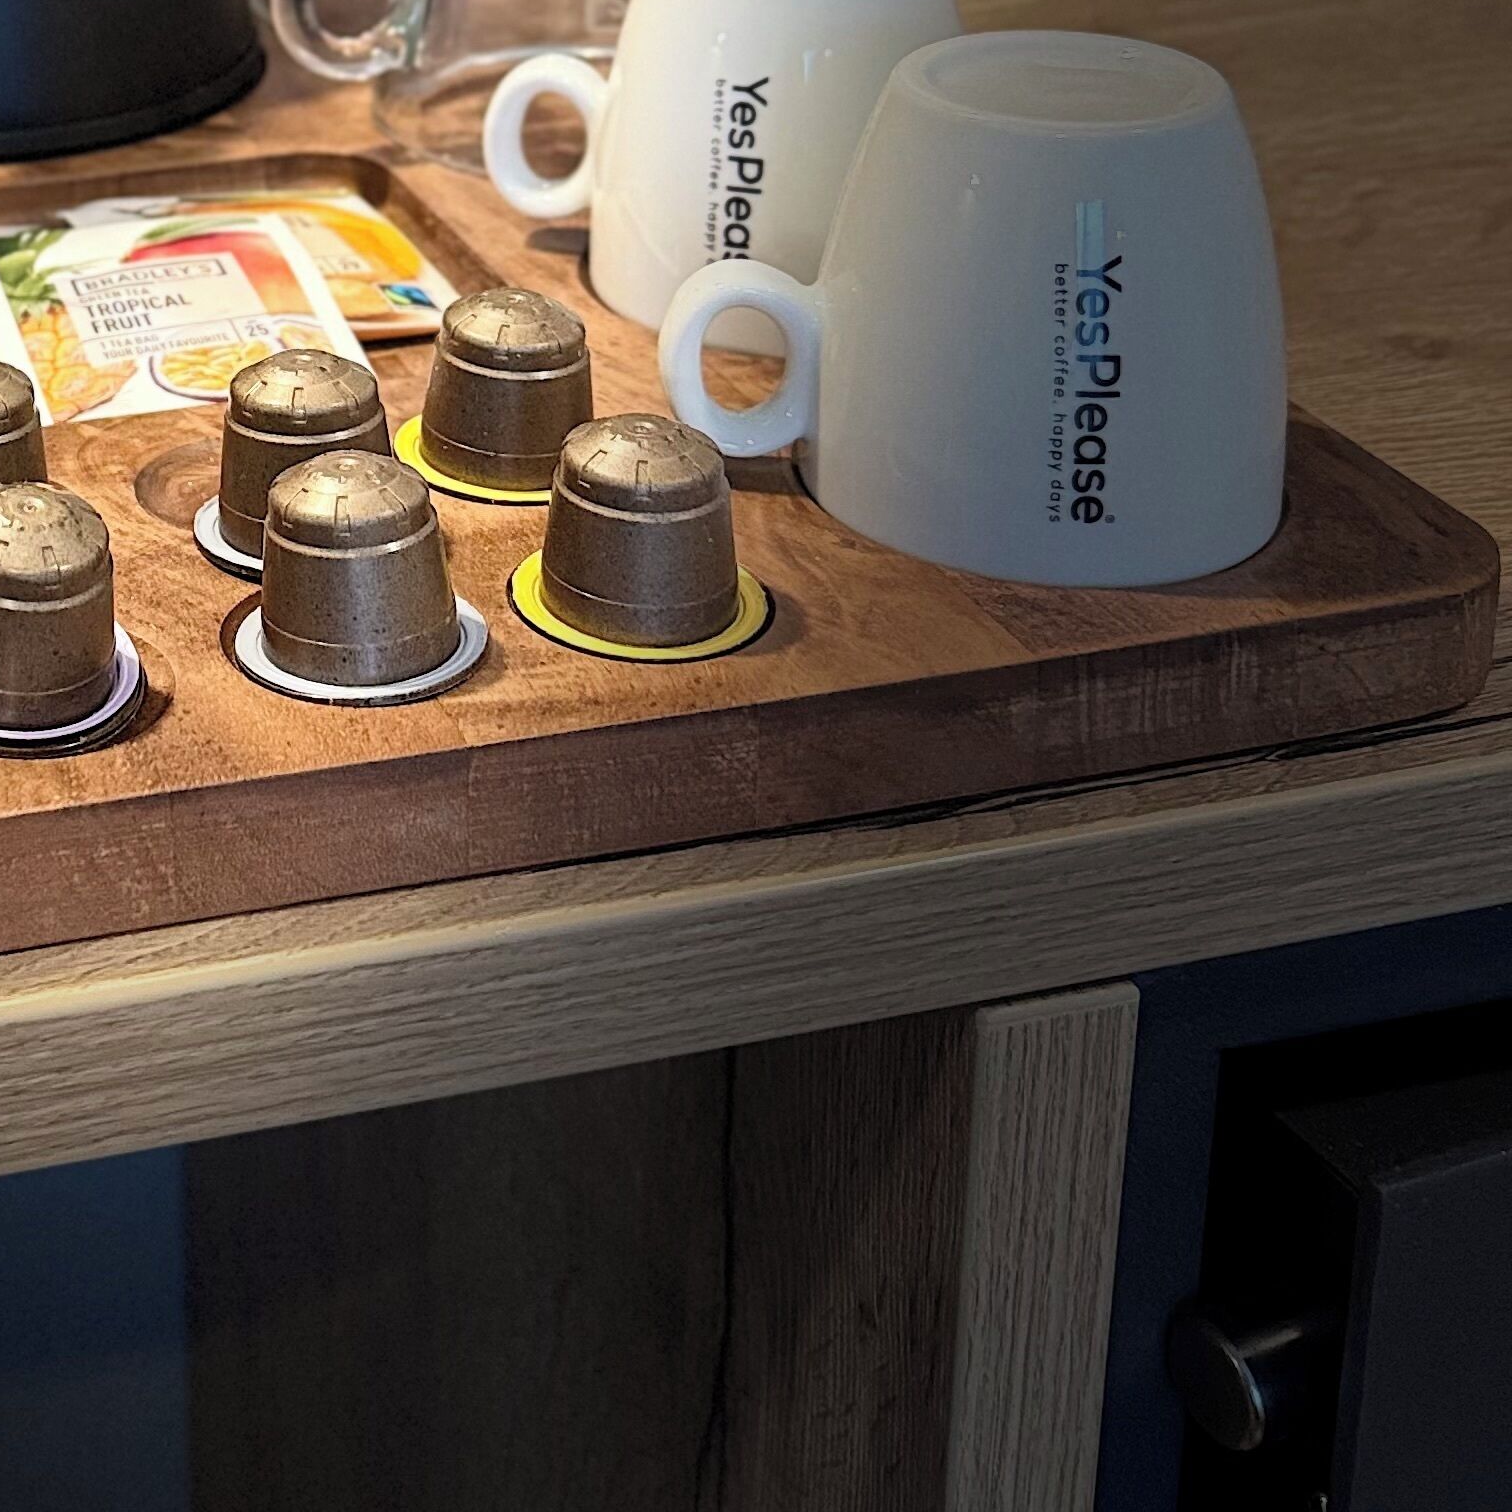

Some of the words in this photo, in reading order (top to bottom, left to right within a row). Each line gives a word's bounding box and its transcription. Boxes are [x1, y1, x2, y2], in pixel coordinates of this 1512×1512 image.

[713, 78, 726, 131] better
[703, 201, 719, 253] happy
[86, 293, 192, 319] TROPICAL
[124, 287, 152, 299] TEA
[1053, 263, 1069, 328] better
[91, 312, 154, 335] FRUIT
[244, 323, 270, 338] 25
[102, 346, 134, 360] YOUR
[167, 331, 233, 351] FAVOURITE
[110, 337, 133, 349] TEA
[1047, 413, 1068, 473] happy
[1047, 478, 1065, 523] days
